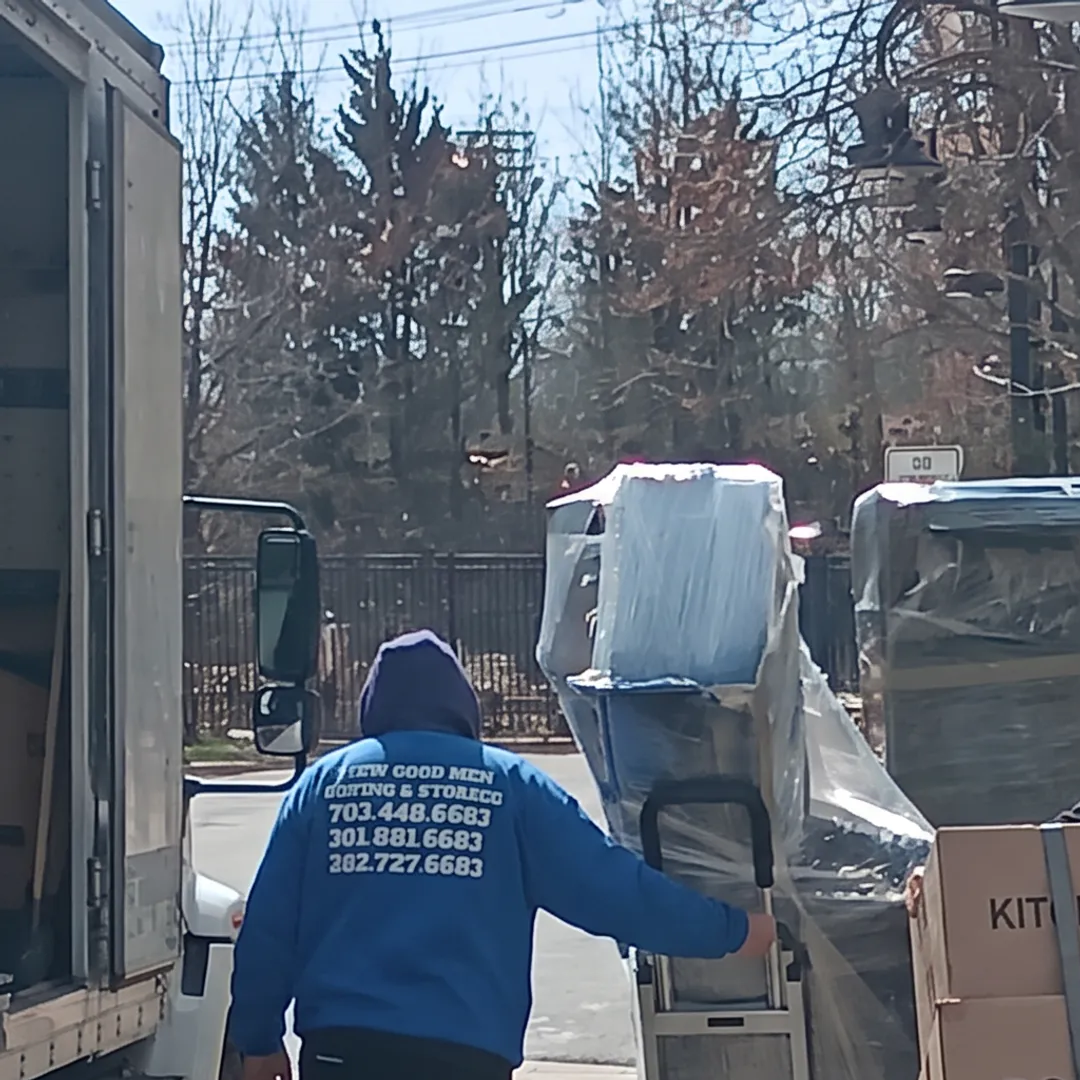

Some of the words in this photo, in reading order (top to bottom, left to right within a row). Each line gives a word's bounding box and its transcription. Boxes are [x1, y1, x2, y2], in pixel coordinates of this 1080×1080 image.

[392, 764, 445, 780] GOOD
[448, 766, 495, 785] MEN
[400, 783, 413, 798] &
[329, 801, 492, 828] 703.448.6683
